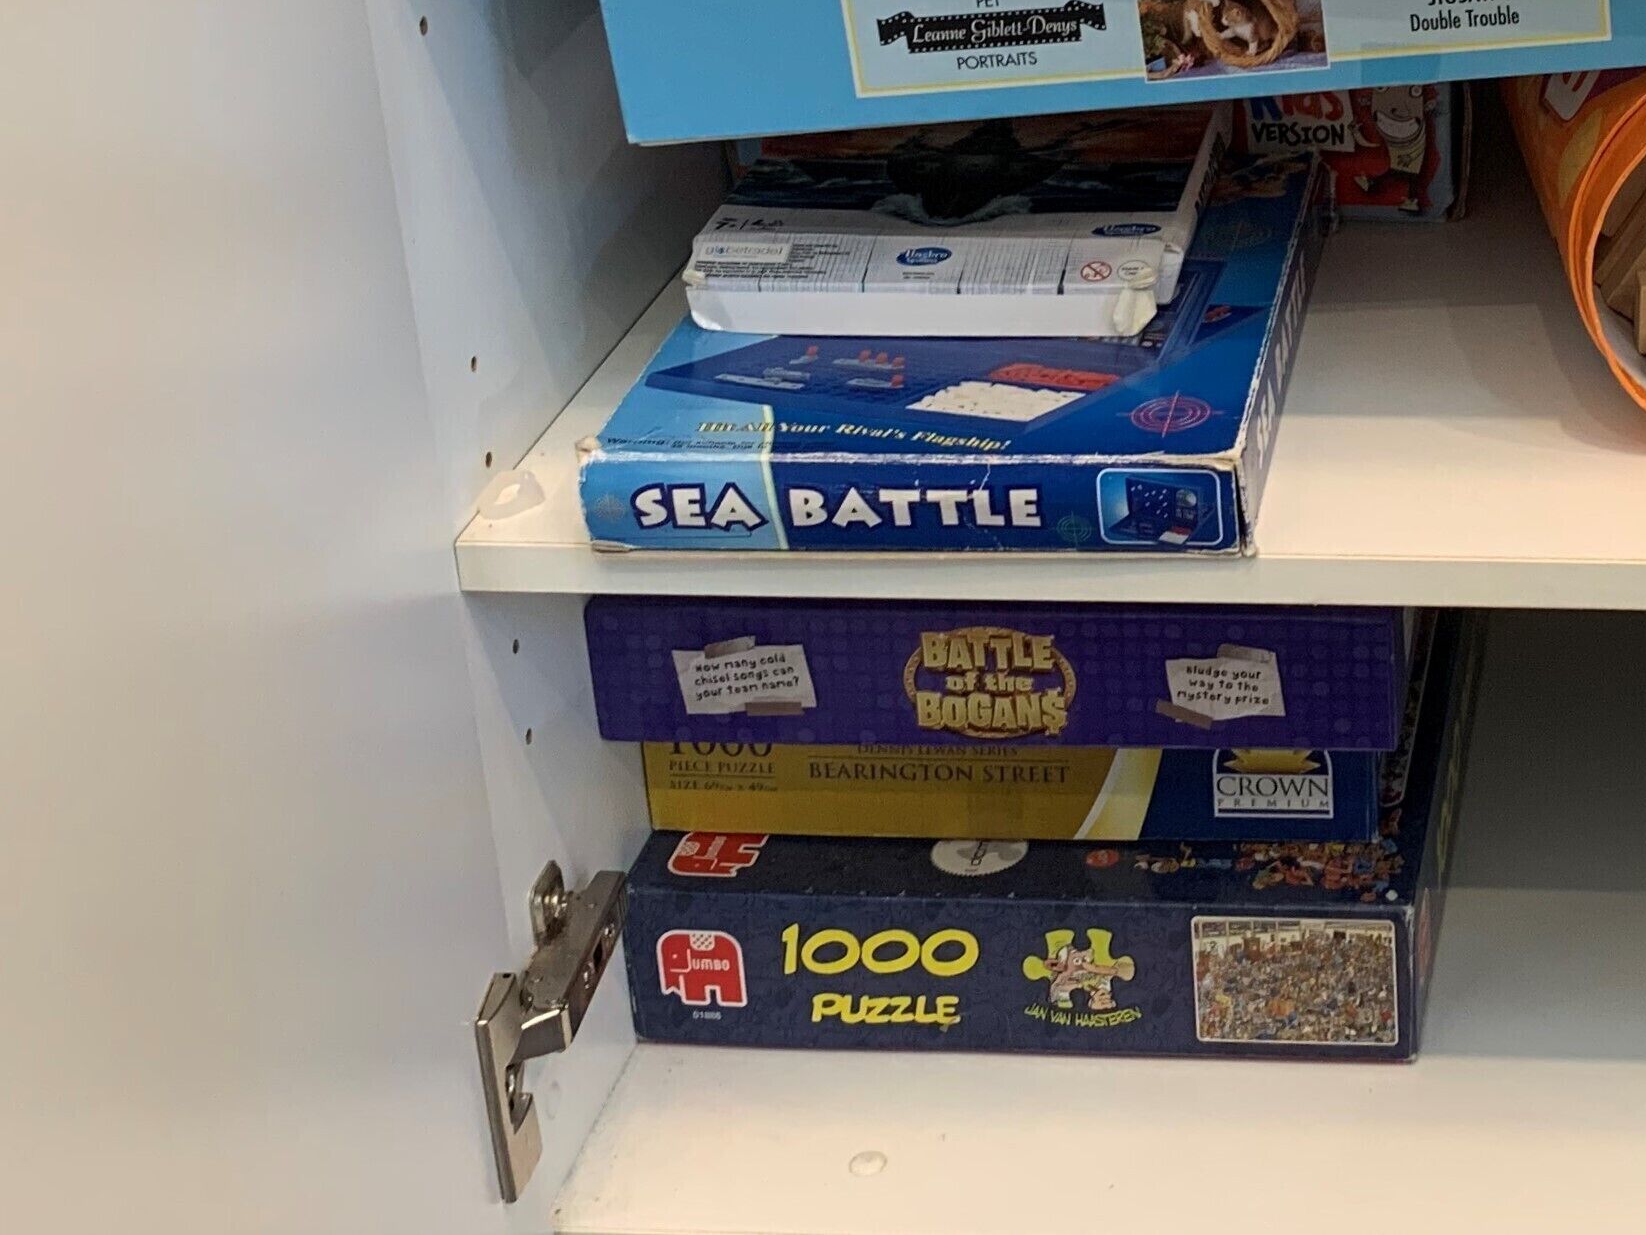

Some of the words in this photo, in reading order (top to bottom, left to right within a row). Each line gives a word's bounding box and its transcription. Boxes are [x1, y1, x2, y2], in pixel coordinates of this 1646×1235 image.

[1410, 8, 1462, 33] Double
[1465, 5, 1520, 29] Trouble
[912, 21, 968, 46] Leanne
[956, 50, 1038, 71] PORTRAITS
[1250, 121, 1345, 147] VERSION
[776, 422, 831, 435] Your
[835, 423, 907, 440] Rival's
[910, 430, 1013, 452] Flagship!
[634, 484, 766, 529] SEA
[787, 486, 1043, 528] BATTLE
[724, 658, 757, 669] many
[759, 652, 786, 665] cold
[919, 632, 1056, 672] BATTLE
[733, 669, 769, 681] songs
[945, 671, 978, 694] of
[984, 669, 1034, 693] the
[1232, 669, 1262, 681] your
[1237, 680, 1259, 692] the
[696, 687, 723, 701] your
[761, 675, 800, 690] name?
[1234, 693, 1270, 706] prize
[717, 761, 775, 774] PUZZLE
[809, 763, 973, 783] BEARINGTON
[982, 764, 1068, 784] STREET
[1216, 775, 1329, 797] CROWN
[1217, 798, 1329, 808] PREMIUM
[781, 922, 980, 977] 1000
[810, 991, 961, 1032] PUZZLE
[1050, 1009, 1072, 1026] VAN
[1075, 1005, 1143, 1028] HAASTEREN
